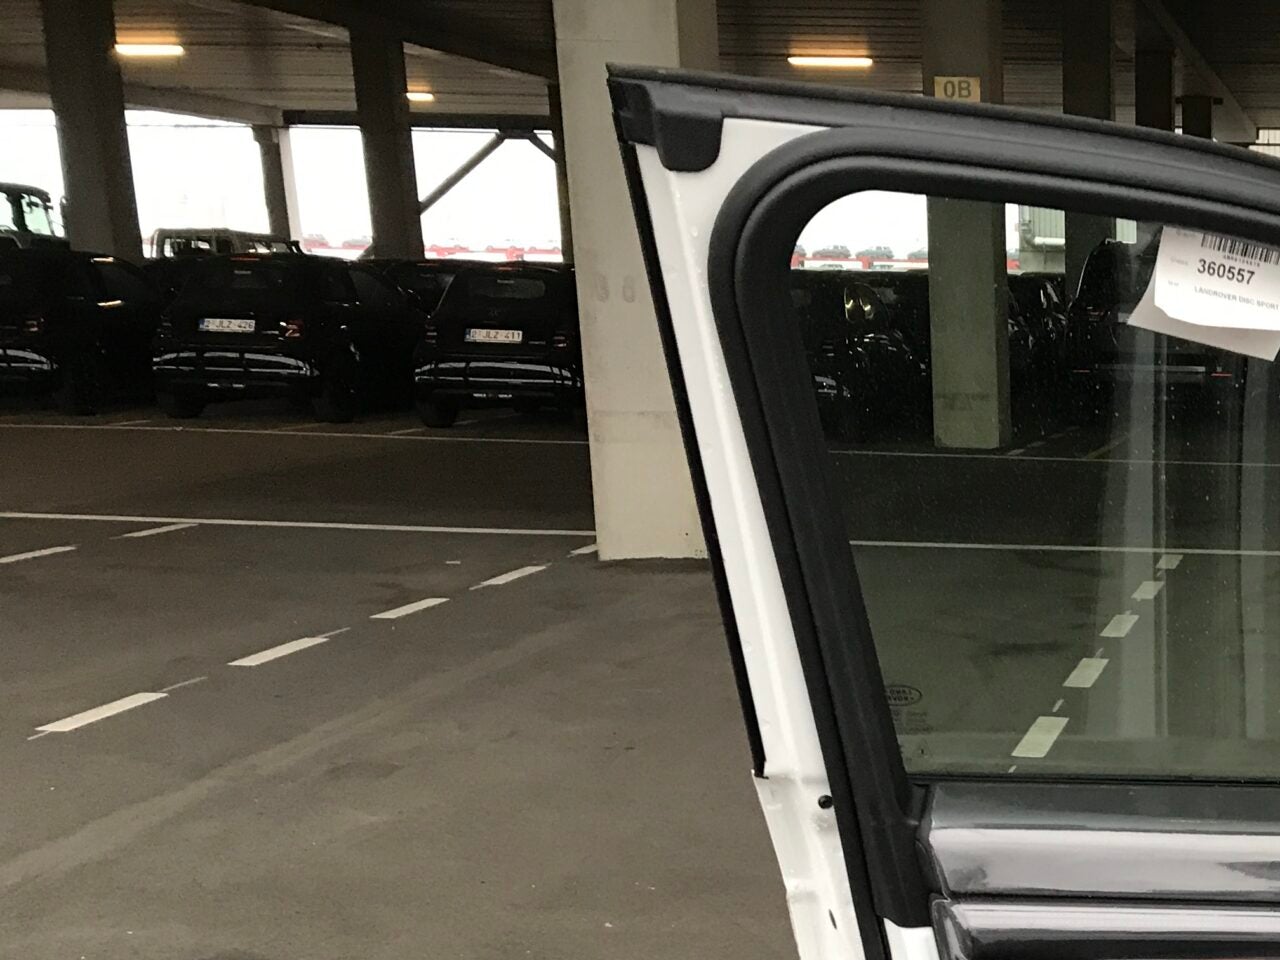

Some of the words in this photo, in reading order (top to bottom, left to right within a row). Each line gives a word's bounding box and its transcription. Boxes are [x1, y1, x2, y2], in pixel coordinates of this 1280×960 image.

[1197, 258, 1256, 285] 360557
[1194, 286, 1237, 302] LANDROVER
[1256, 299, 1279, 310] SPORT
